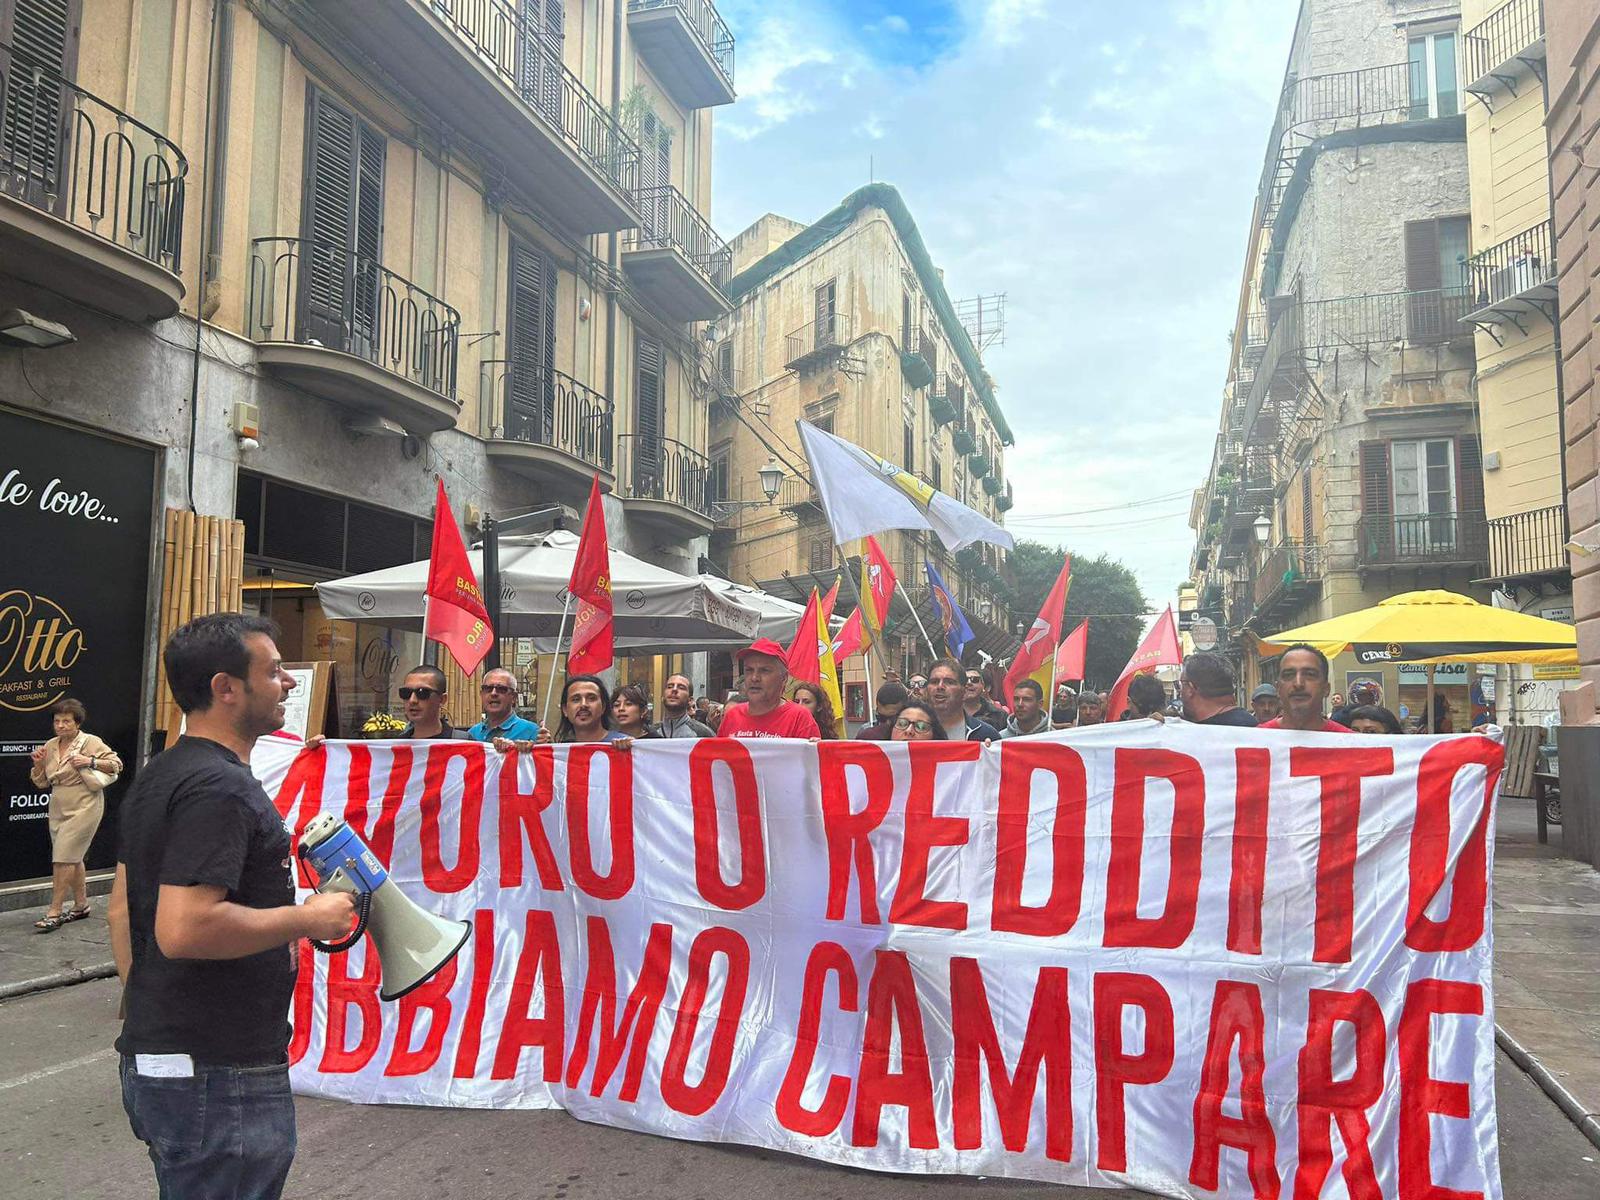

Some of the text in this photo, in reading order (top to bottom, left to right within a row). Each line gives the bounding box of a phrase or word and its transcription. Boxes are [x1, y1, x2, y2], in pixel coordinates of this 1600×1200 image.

[49, 676, 72, 688] GRILL
[10, 793, 52, 808] FOLLO
[273, 735, 1504, 964] AVORO O REDDITO
[286, 909, 1484, 1200] BBIAMO CAMPARE
